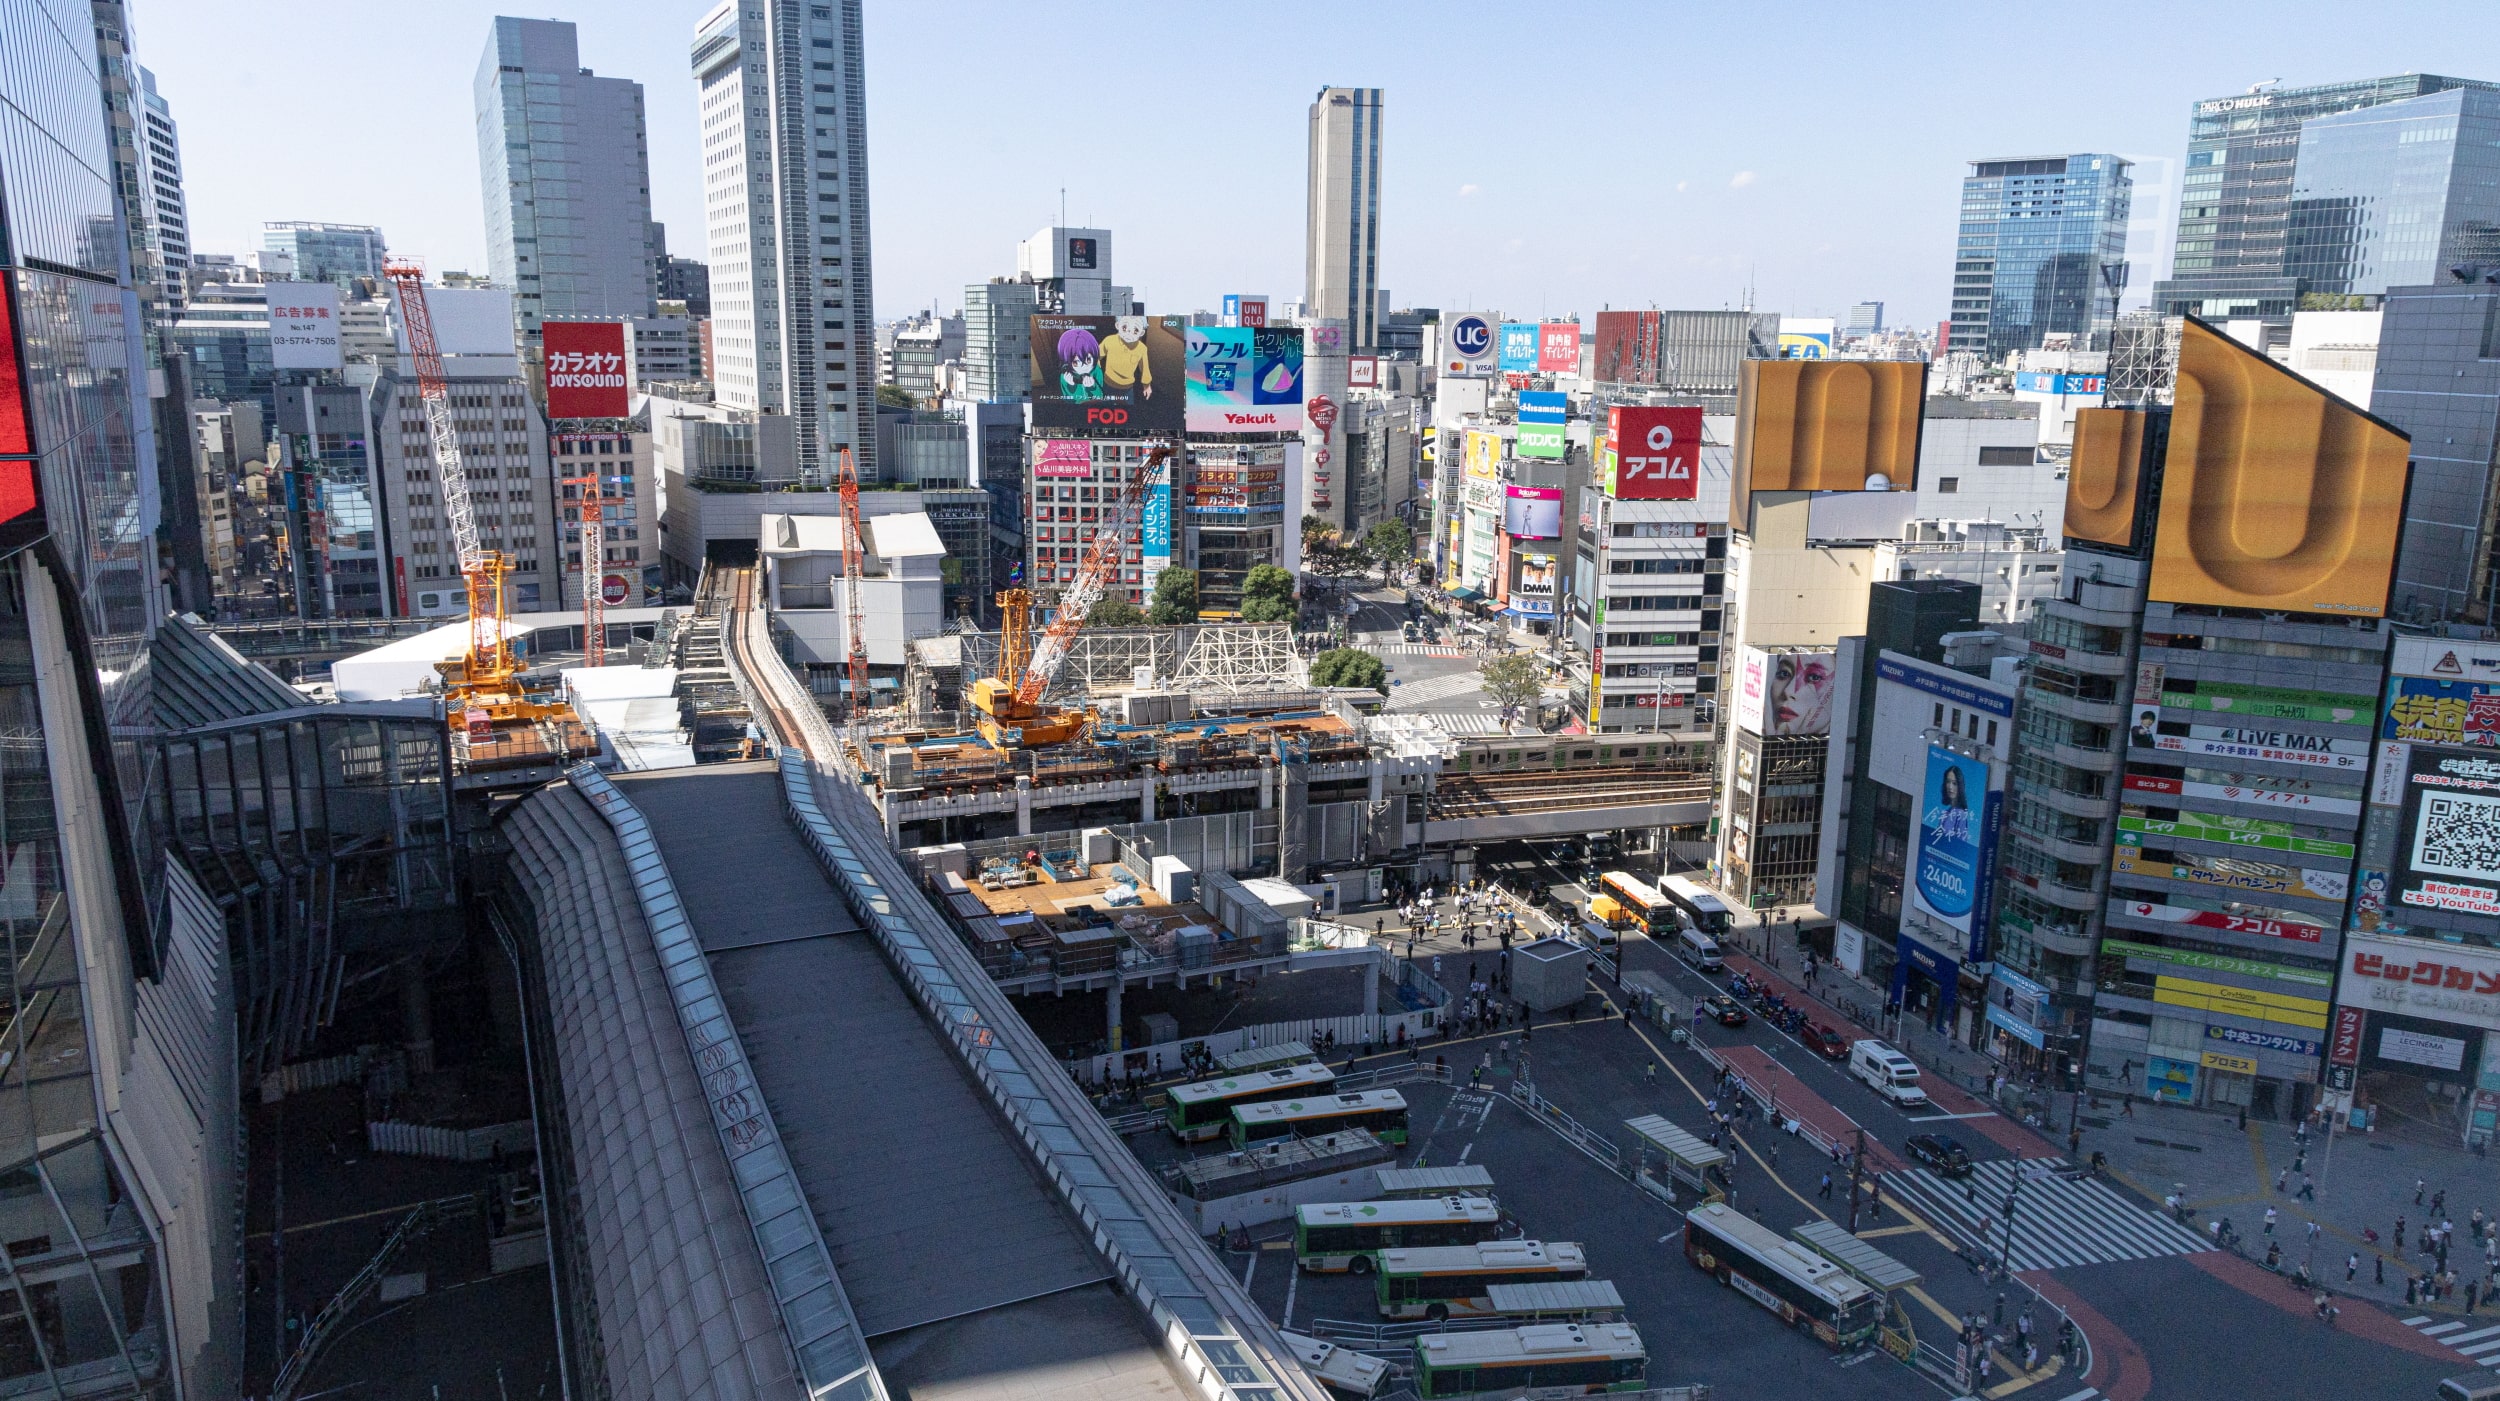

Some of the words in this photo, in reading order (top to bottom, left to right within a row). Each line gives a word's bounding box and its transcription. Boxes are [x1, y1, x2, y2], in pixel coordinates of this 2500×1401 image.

[2200, 100, 2234, 113] PARCO
[2235, 96, 2271, 108] HULIC
[274, 307, 330, 318] 広告募集
[1244, 305, 1261, 314] UNI
[1244, 316, 1262, 326] QLO
[1254, 334, 1304, 345] ヤクルトの
[1311, 327, 1341, 350] 109
[1192, 342, 1250, 358] ソフール
[1254, 346, 1304, 358] ヨーグルト
[549, 352, 622, 372] カラオケ
[550, 374, 624, 388] JOYSOUND
[1087, 408, 1128, 424] FOD
[1520, 403, 1565, 413] Hisamitsu
[1224, 414, 1276, 424] Yakult
[1520, 432, 1561, 448] サロンパス
[1626, 457, 1689, 479] アコム
[1208, 495, 1233, 504] ガスト
[1523, 584, 1552, 594] DMM
[1882, 664, 1904, 676] MIZUHO
[2286, 734, 2333, 752] MAX
[2396, 726, 2465, 743] SHIBUYA
[2475, 734, 2495, 746] AI
[2205, 744, 2258, 756] 仲介手数料
[2262, 749, 2329, 764] 家賃の半月分
[2338, 757, 2354, 767] 9F
[1772, 760, 1806, 772] Lindt
[2414, 774, 2450, 785] 2023年
[2253, 790, 2310, 804] アイフル
[2145, 821, 2176, 832] レイク
[2230, 831, 2262, 843] レイク
[2119, 859, 2133, 870] 6F
[2191, 869, 2293, 892] タウンハウジング
[2425, 883, 2494, 899] 順位の続きは
[2405, 892, 2437, 904] こちら
[2441, 897, 2500, 912] YouTube
[2225, 915, 2282, 936] アコム
[2300, 928, 2319, 939] 5F
[1913, 950, 1935, 968] MIZUHO
[2180, 953, 2272, 976] マインドフルネス
[2003, 970, 2039, 992] intimissimi
[1997, 1013, 2032, 1035] intimissimi
[2225, 1029, 2302, 1051] 中央コンタクト
[2337, 1012, 2357, 1056] カラオケ
[2208, 1056, 2249, 1069] プロミス
